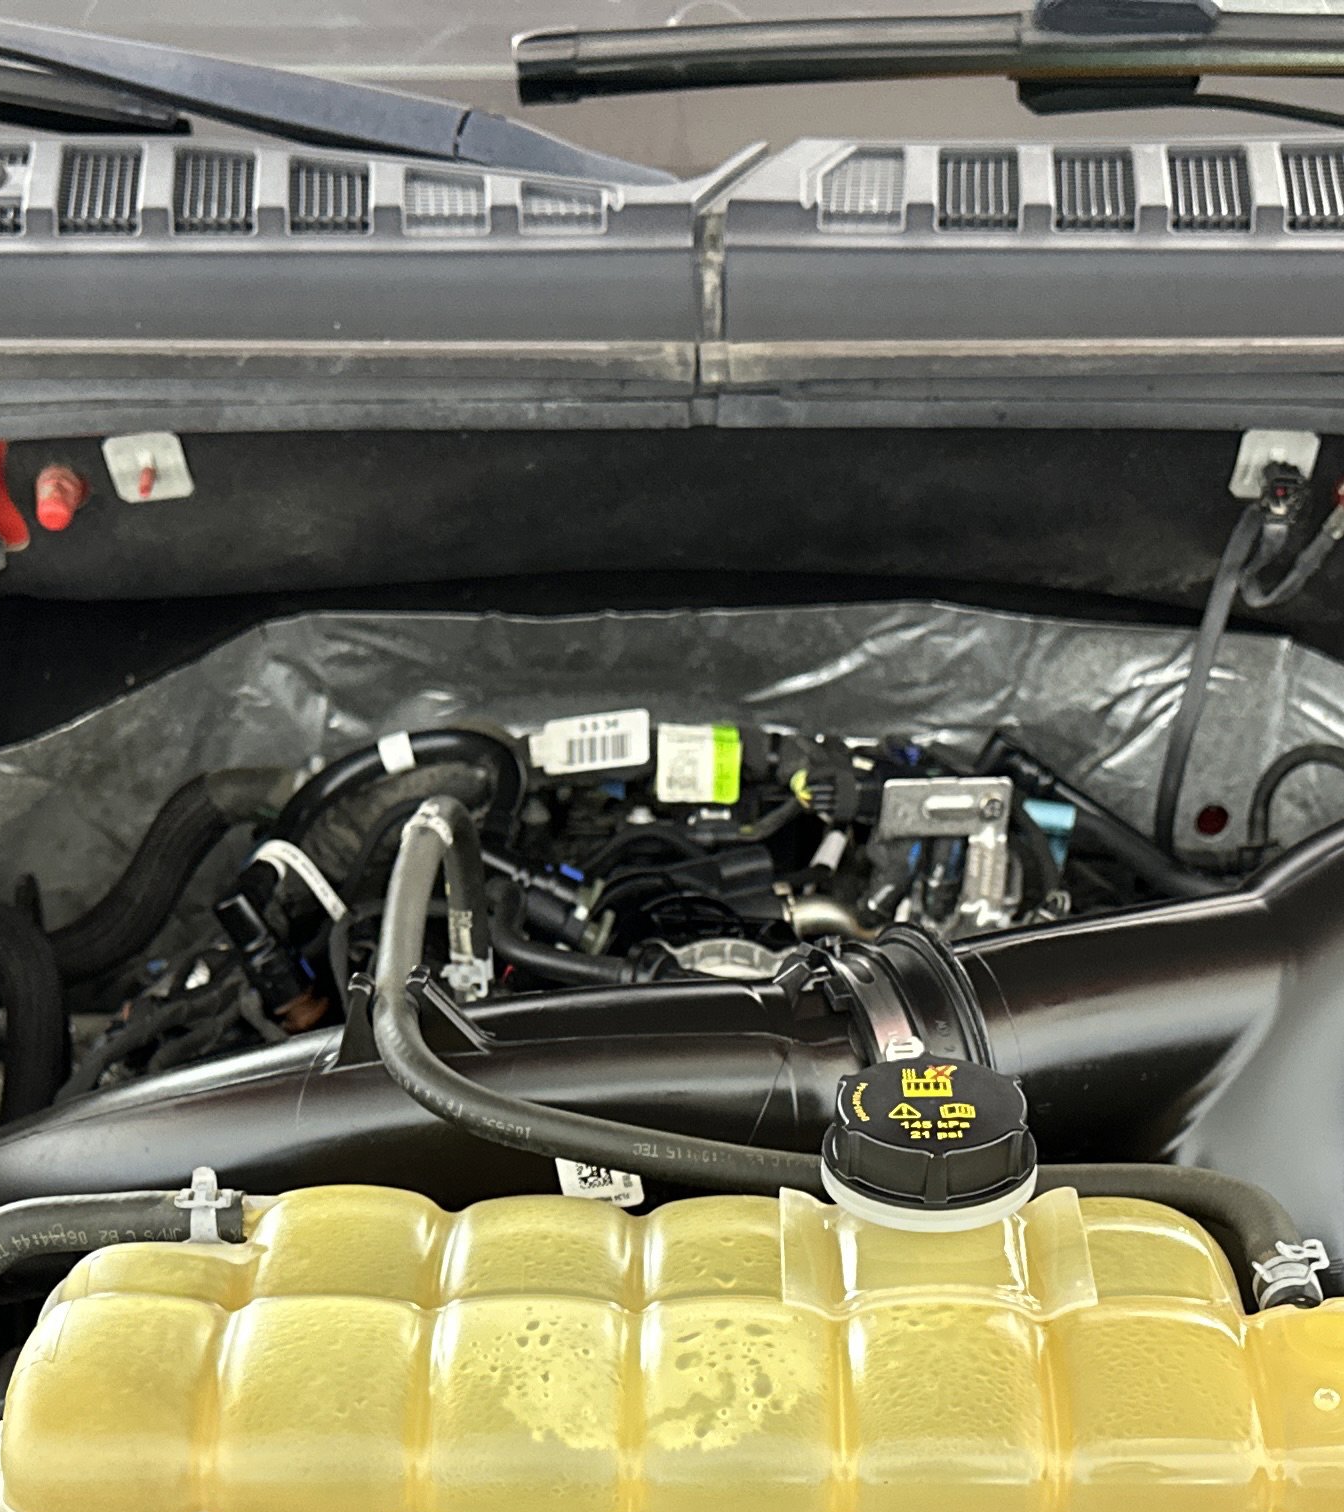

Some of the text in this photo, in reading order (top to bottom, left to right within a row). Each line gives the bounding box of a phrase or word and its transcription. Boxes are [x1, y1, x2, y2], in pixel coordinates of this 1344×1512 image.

[900, 1121, 970, 1129] 145 kPa
[910, 1131, 963, 1140] 21 psi
